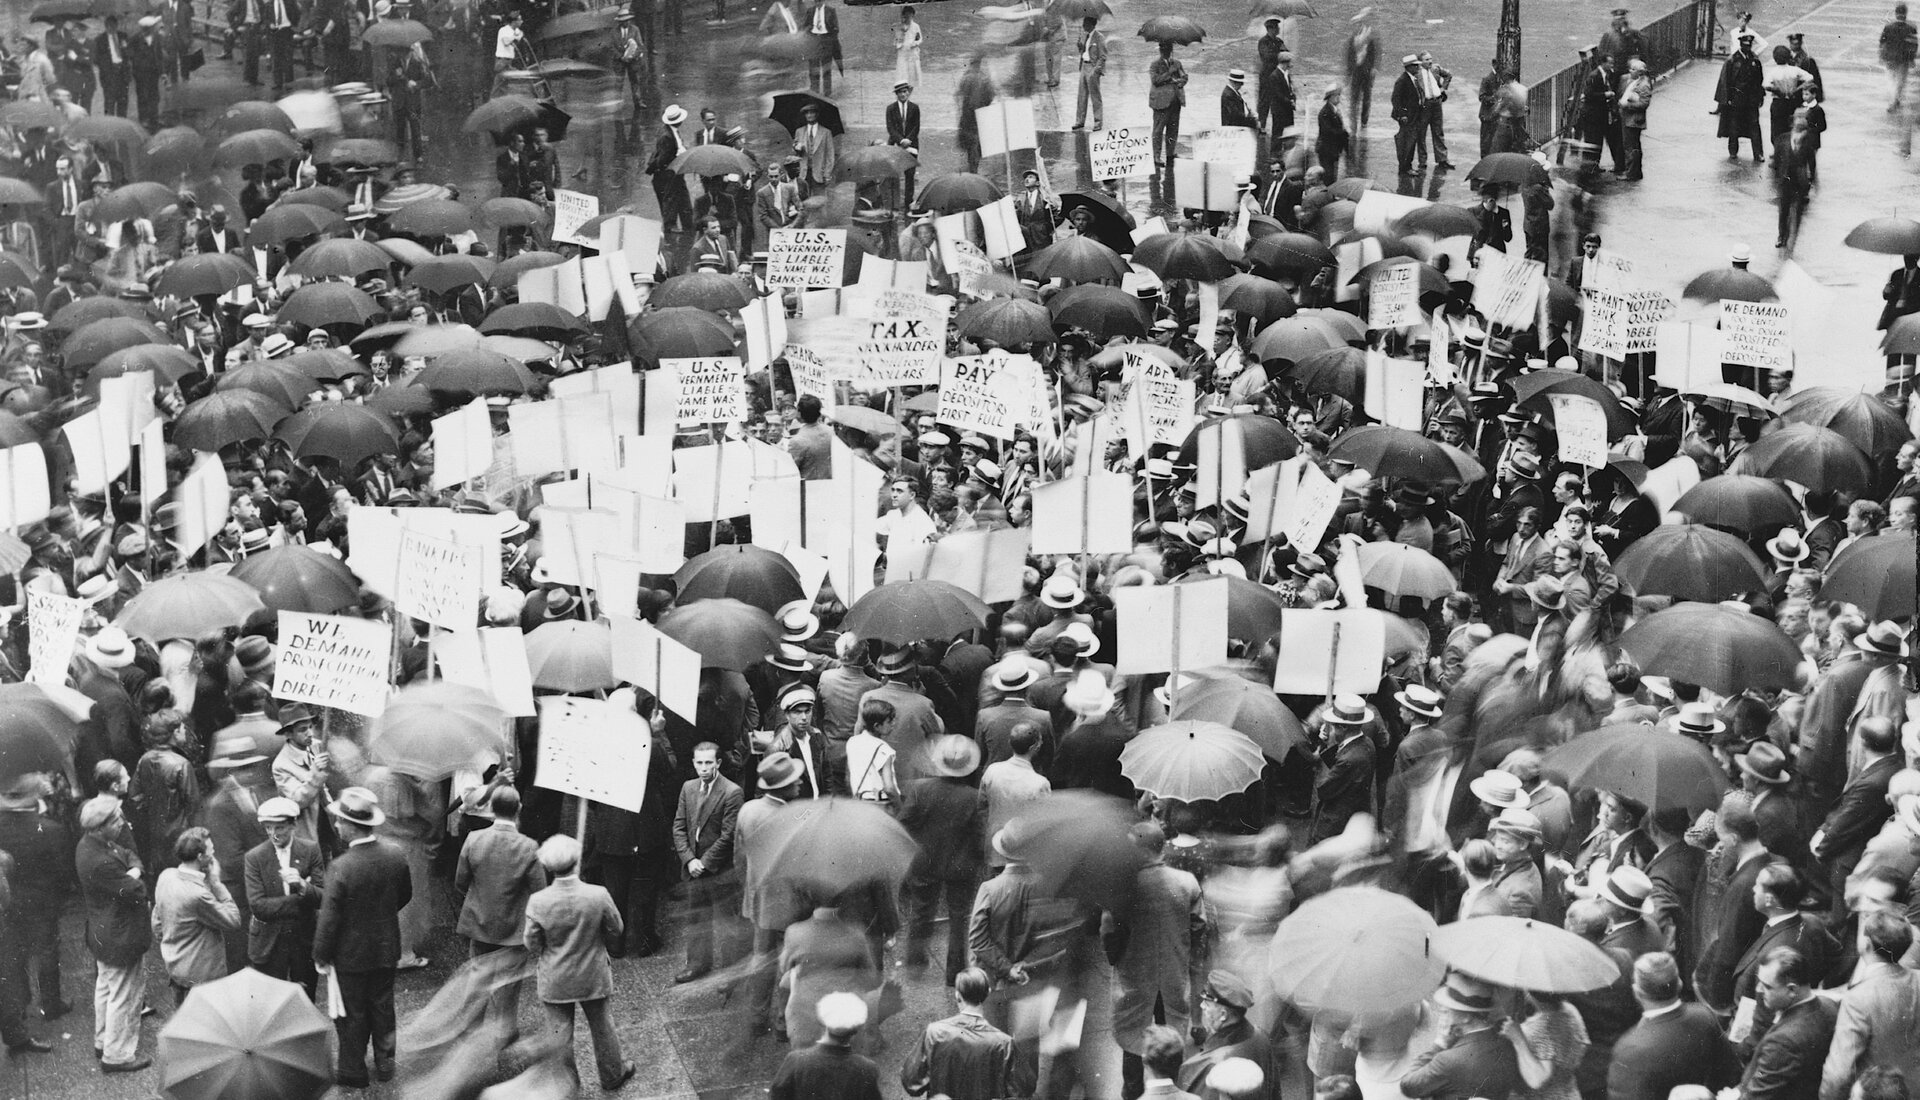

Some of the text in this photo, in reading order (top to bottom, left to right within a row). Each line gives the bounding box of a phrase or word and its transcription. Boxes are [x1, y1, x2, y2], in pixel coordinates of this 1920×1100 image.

[1107, 128, 1129, 140] NO
[1094, 137, 1148, 151] EVICTIONS
[1107, 164, 1135, 176] RENT
[561, 193, 590, 208] UNITED
[794, 232, 830, 244] U.S.
[772, 244, 842, 254] GOVERNMENT
[786, 254, 831, 264] LIABLE
[784, 265, 808, 274] NAME
[812, 265, 834, 274] WAS
[1377, 268, 1412, 282] UNITE
[769, 274, 796, 285] BANK
[1583, 288, 1624, 311] WE WANT
[1724, 303, 1787, 318] WE DEMAND
[1628, 314, 1663, 325] OSSES
[869, 320, 921, 338] TAX
[1626, 326, 1657, 338] BBE
[1626, 340, 1656, 350] ANKE
[1125, 351, 1143, 368] WE
[1725, 351, 1781, 366] DEPOSITOR
[692, 361, 728, 374] U.S.
[955, 362, 996, 386] PAY
[680, 373, 738, 385] VERNMENT
[682, 385, 724, 395] LIABLE
[952, 381, 998, 399] SMALL
[713, 394, 735, 404] WAS
[942, 391, 1007, 416] DEPOSITORS
[677, 408, 698, 418] ANK
[713, 406, 738, 419] U.S.
[940, 408, 1003, 428] FIRST FULL
[280, 680, 362, 704] DIRECTOR
